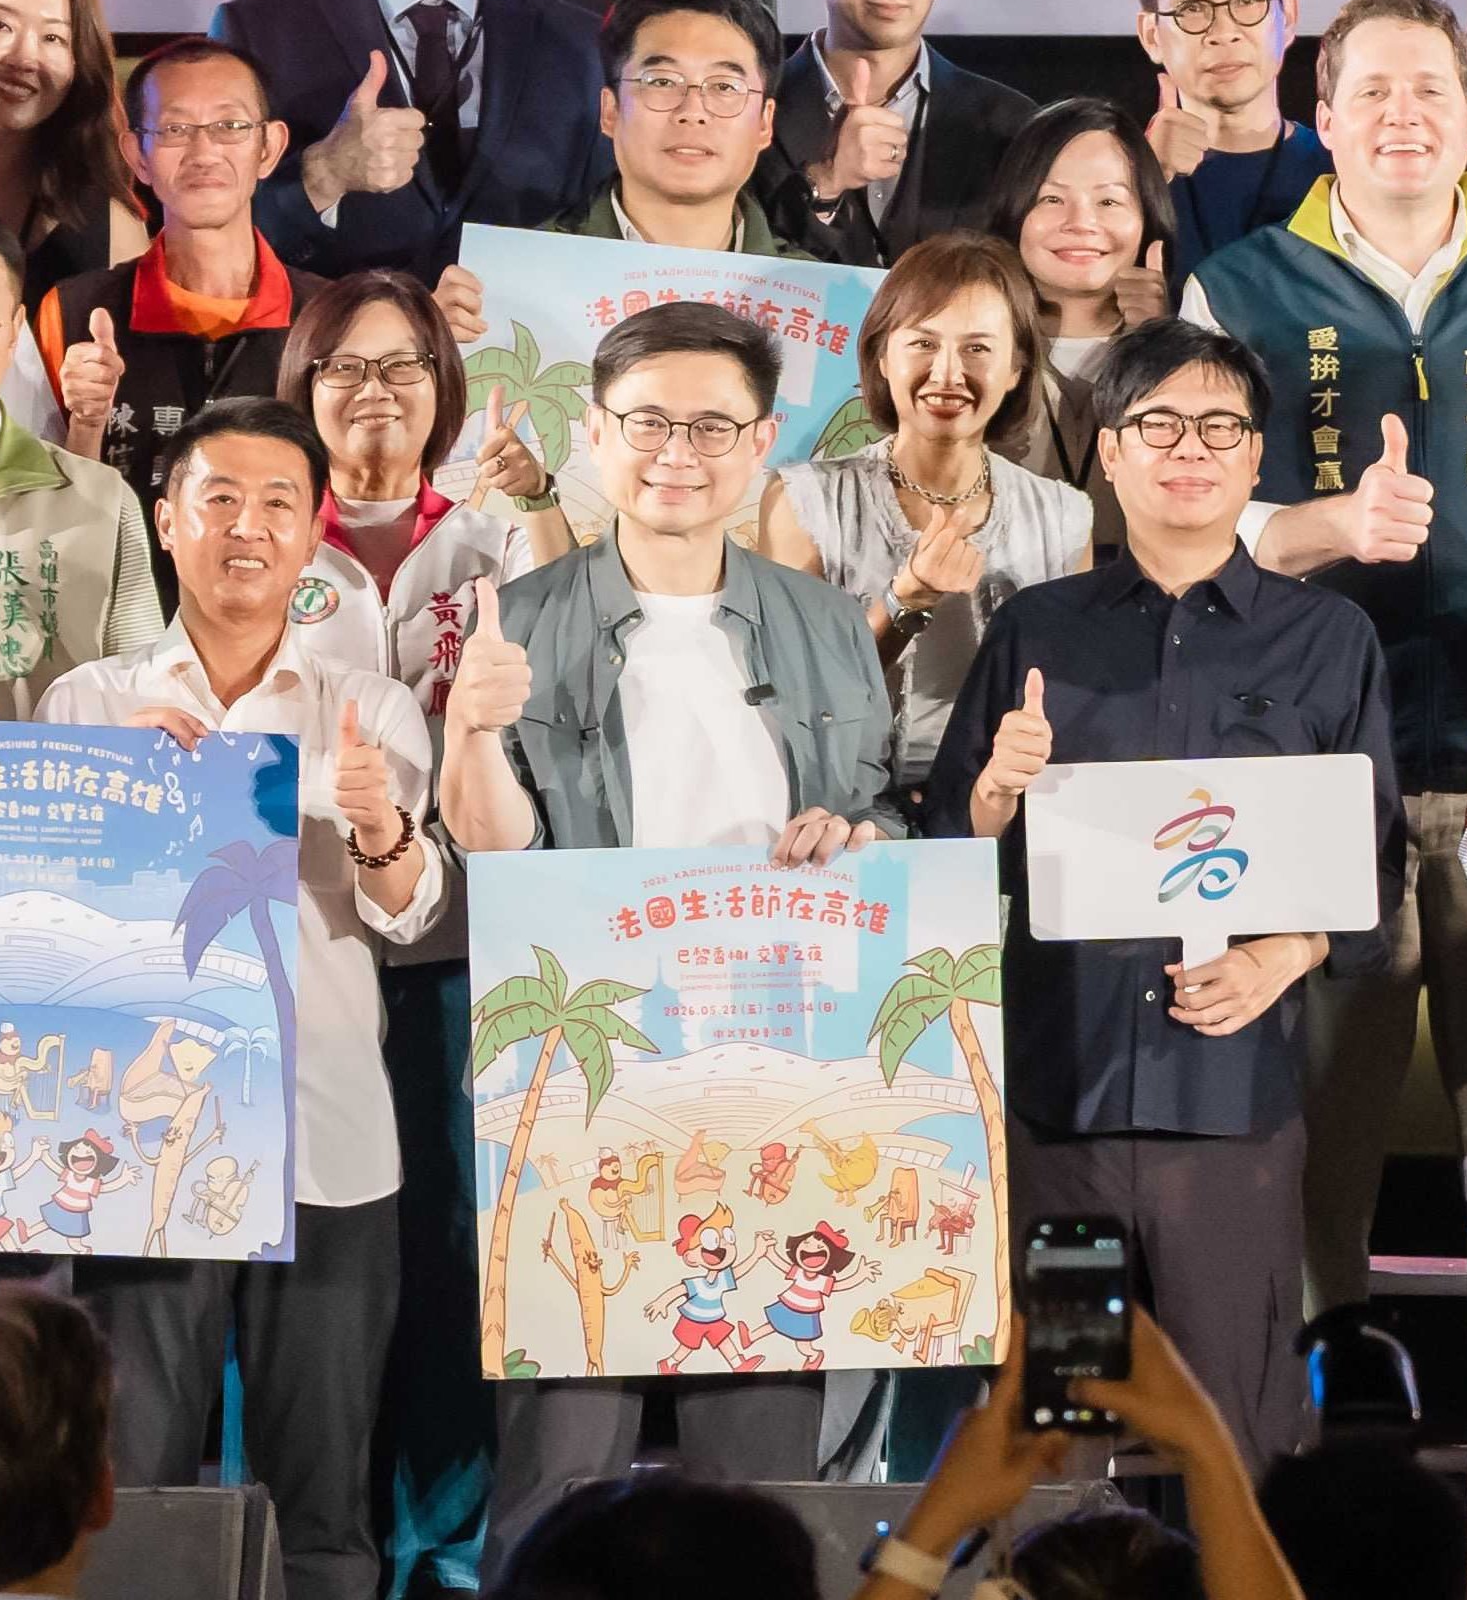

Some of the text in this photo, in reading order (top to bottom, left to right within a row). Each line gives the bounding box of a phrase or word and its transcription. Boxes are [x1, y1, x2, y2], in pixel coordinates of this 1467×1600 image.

[772, 279, 823, 303] FESTIVAL
[42, 740, 83, 753] FRENCH
[87, 746, 135, 766] FESTIVAL
[674, 863, 743, 881] KAOHSIUNG
[800, 866, 855, 883] FESTIVAL
[607, 884, 892, 943] 法國生活節在高雄
